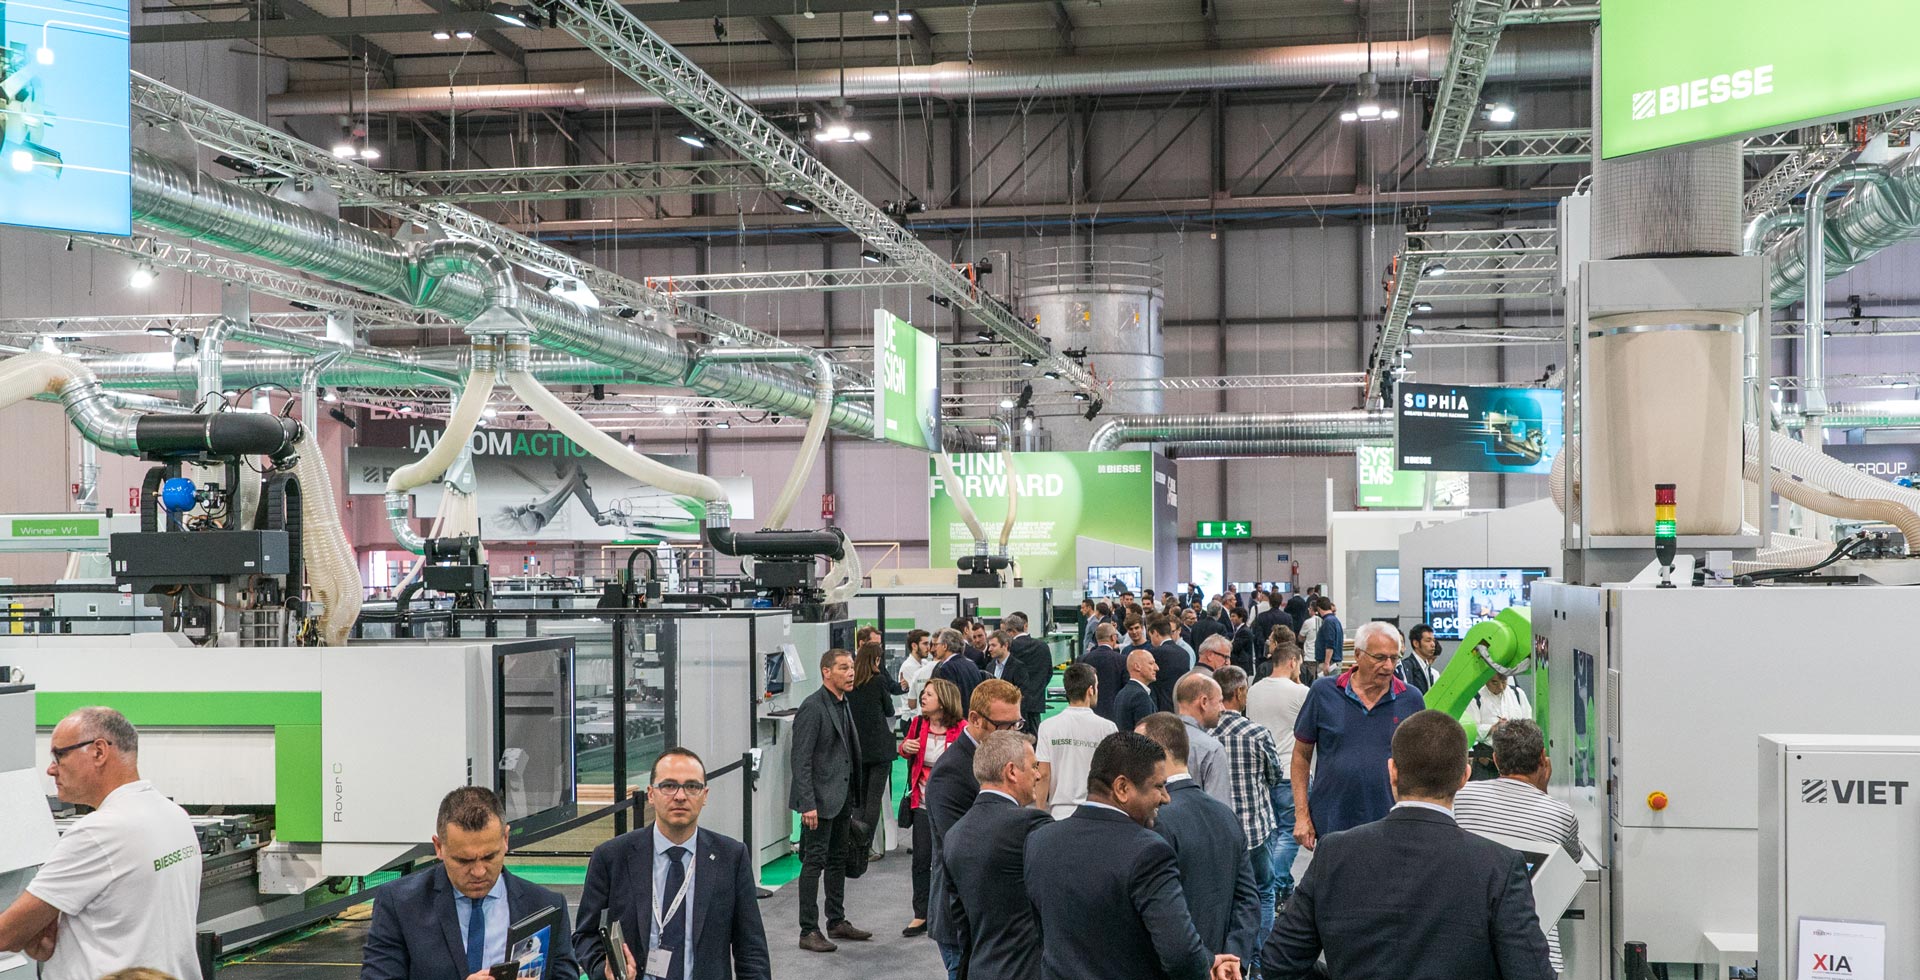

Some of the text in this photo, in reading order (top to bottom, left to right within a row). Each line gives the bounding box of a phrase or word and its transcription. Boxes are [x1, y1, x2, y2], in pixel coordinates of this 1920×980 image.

[1660, 64, 1774, 115] BIESSE
[884, 350, 906, 395] SIGN
[1106, 465, 1141, 473] BIESSE
[1360, 466, 1394, 485] EMS
[20, 526, 78, 535] Winner W1
[1479, 579, 1495, 588] TO
[1497, 579, 1520, 588] THE
[1432, 600, 1453, 608] WITH
[332, 762, 343, 822] Rover C
[1831, 780, 1909, 805] VIET
[1812, 953, 1852, 973] XIA
